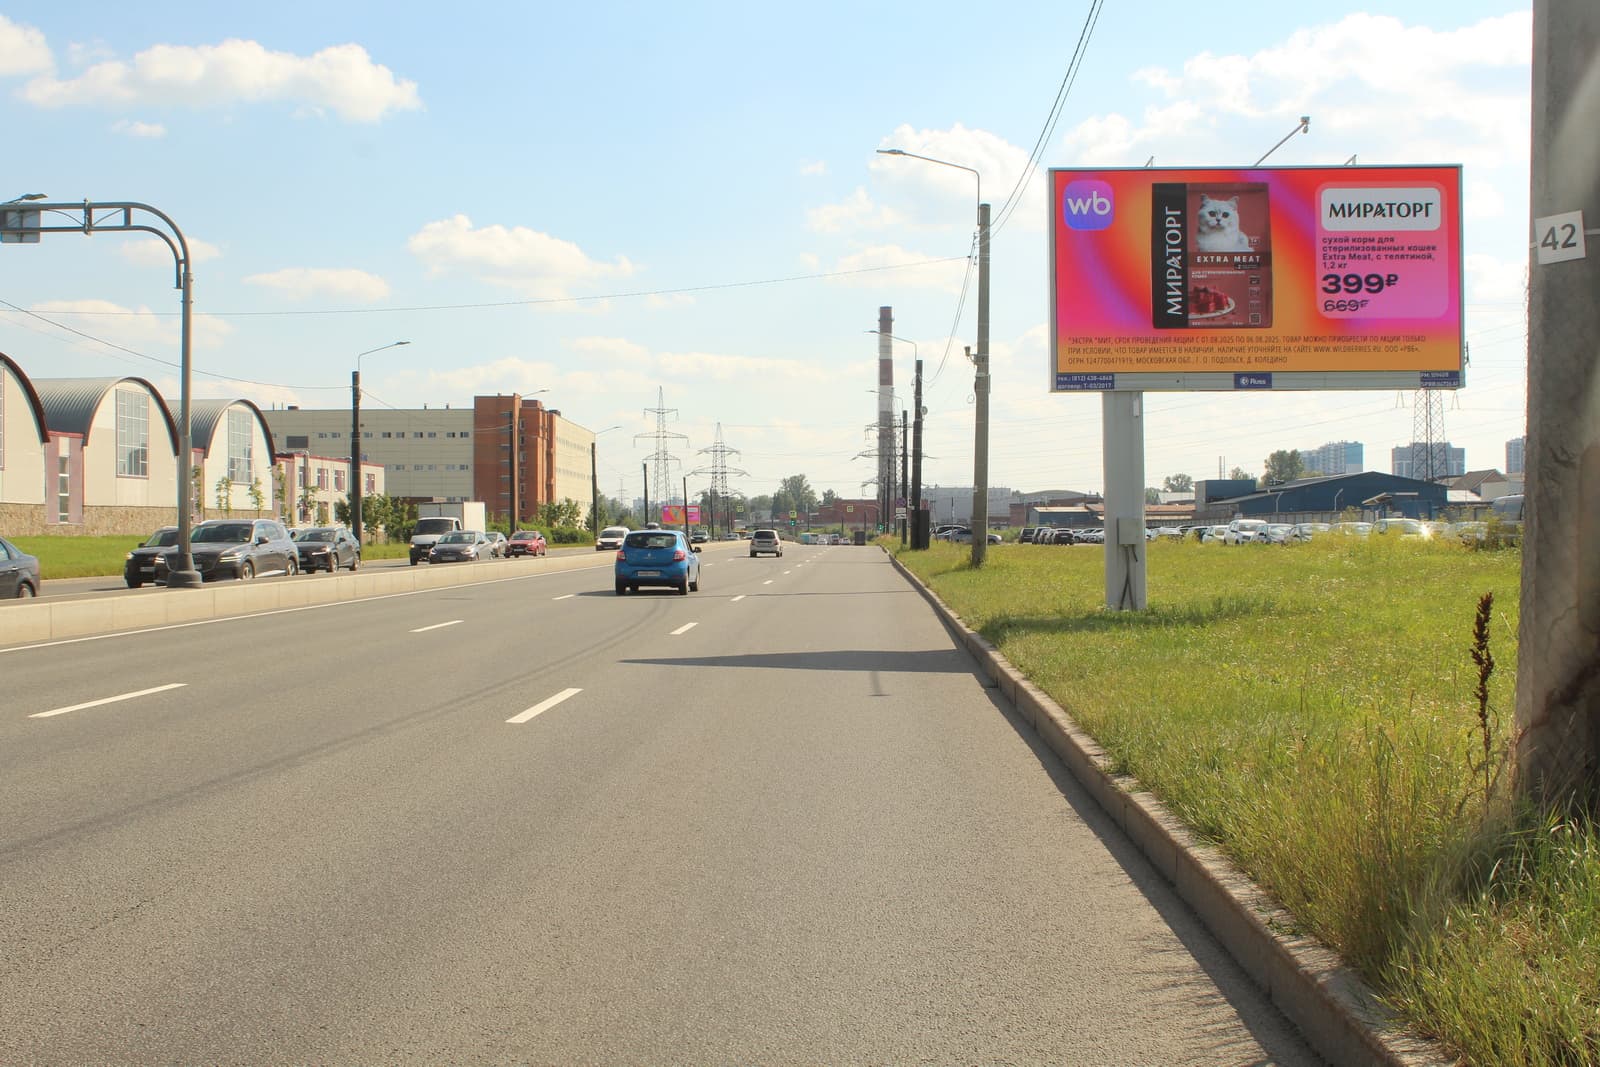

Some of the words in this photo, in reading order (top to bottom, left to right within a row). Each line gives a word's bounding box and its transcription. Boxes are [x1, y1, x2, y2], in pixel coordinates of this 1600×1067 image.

[1068, 190, 1111, 215] wb
[1329, 202, 1433, 218] МИРАТОРГ
[1322, 236, 1349, 244] сухой
[1541, 223, 1577, 250] 42
[1166, 206, 1182, 315] МИРАТОРГ
[1196, 255, 1229, 263] EXTRA
[1233, 255, 1261, 263] MEAT
[1348, 253, 1374, 261] Meat,
[1323, 262, 1336, 270] 1,2
